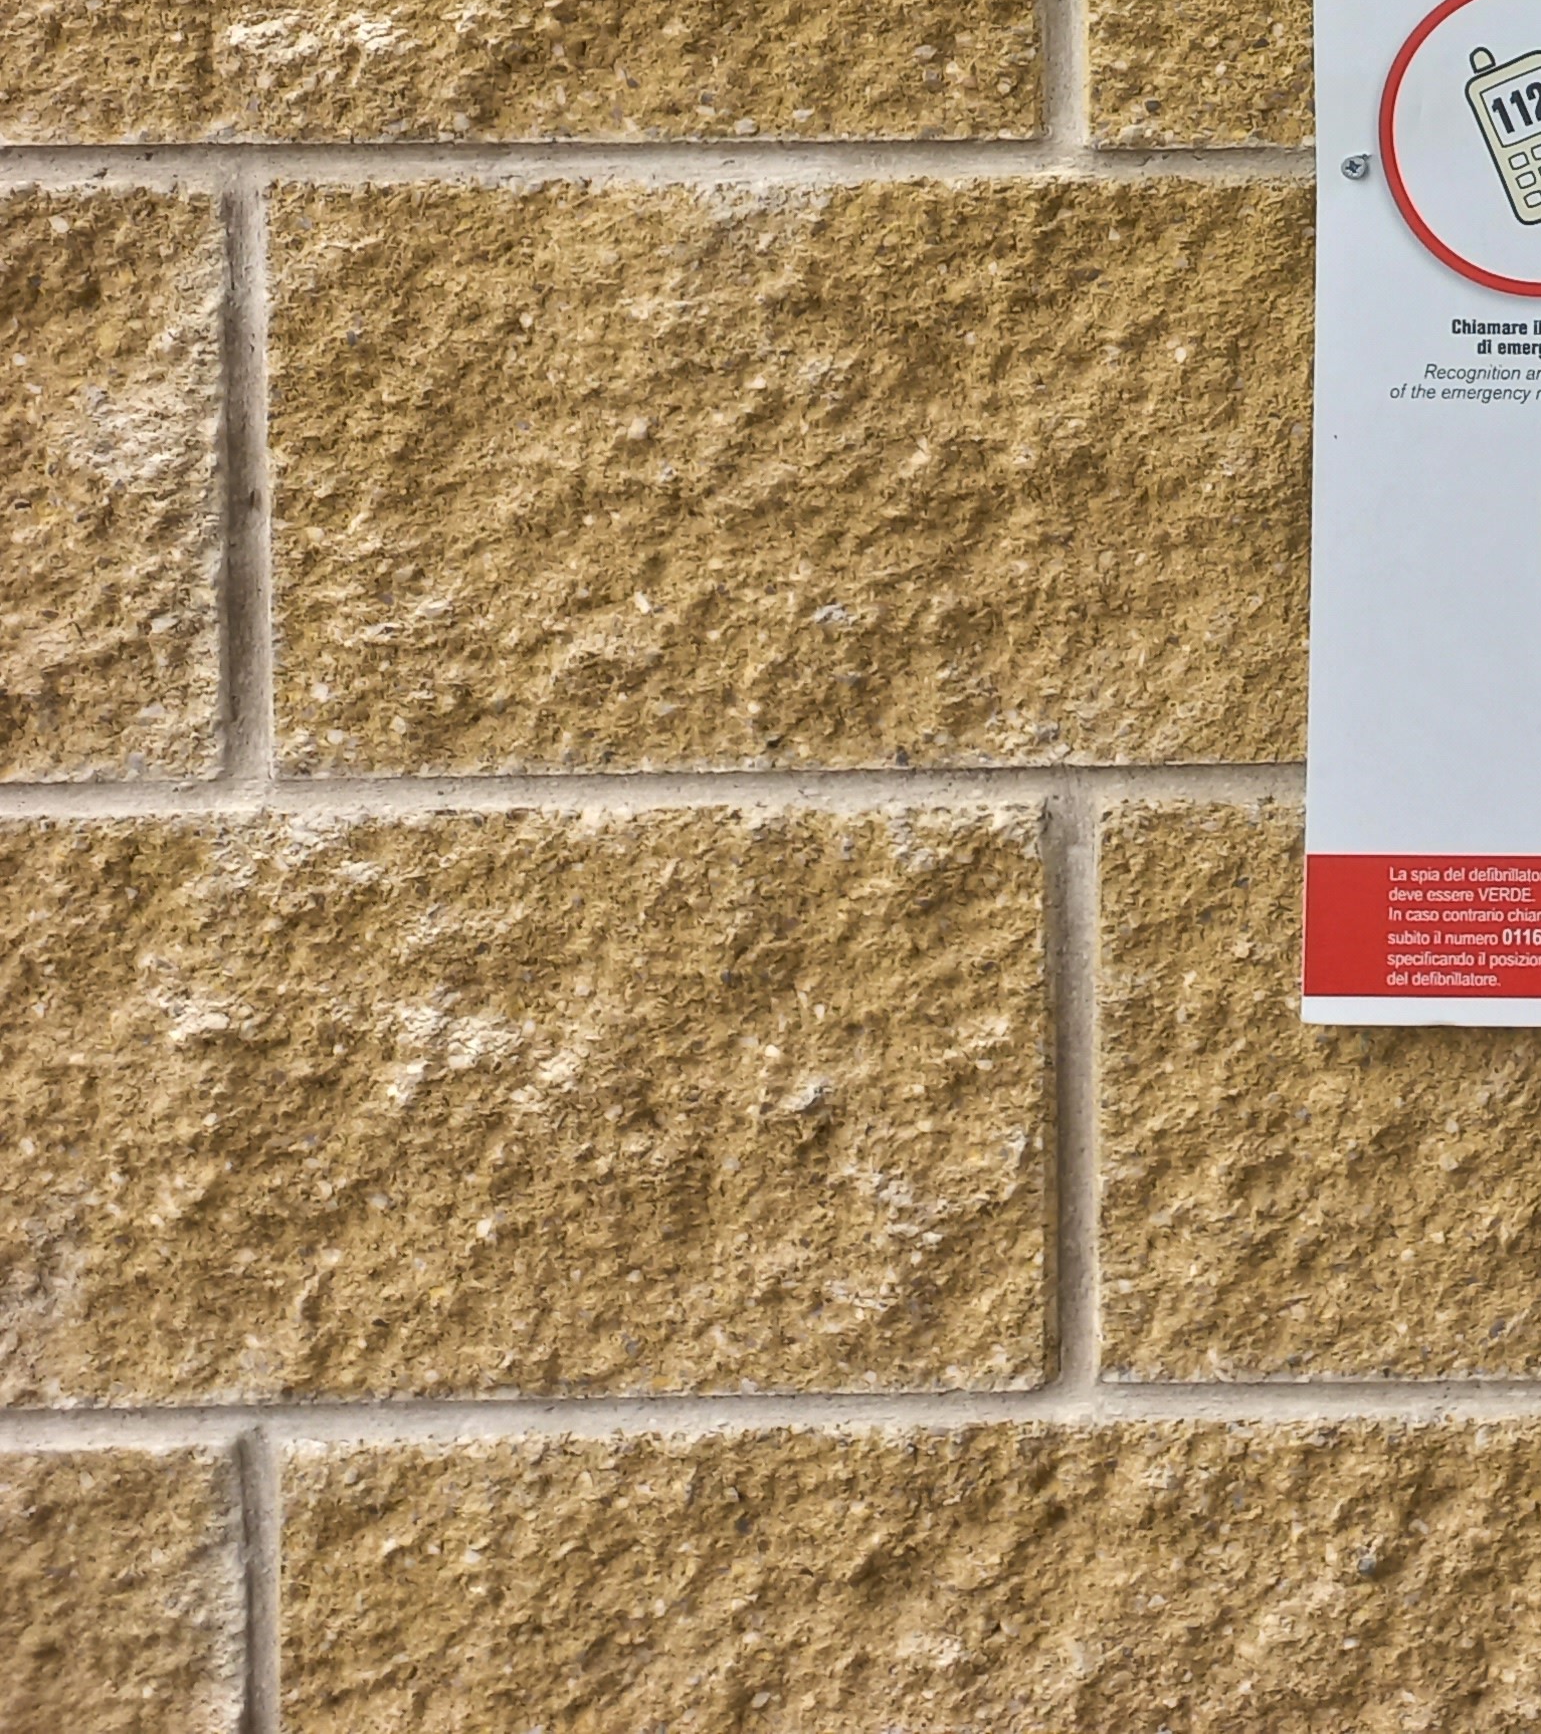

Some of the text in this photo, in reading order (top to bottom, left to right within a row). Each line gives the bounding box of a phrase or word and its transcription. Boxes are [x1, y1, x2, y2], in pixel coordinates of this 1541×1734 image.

[1452, 319, 1527, 335] Chiamare
[1478, 340, 1491, 354] di
[1388, 931, 1429, 944] subito
[1434, 931, 1441, 944] il
[1445, 934, 1498, 945] numero
